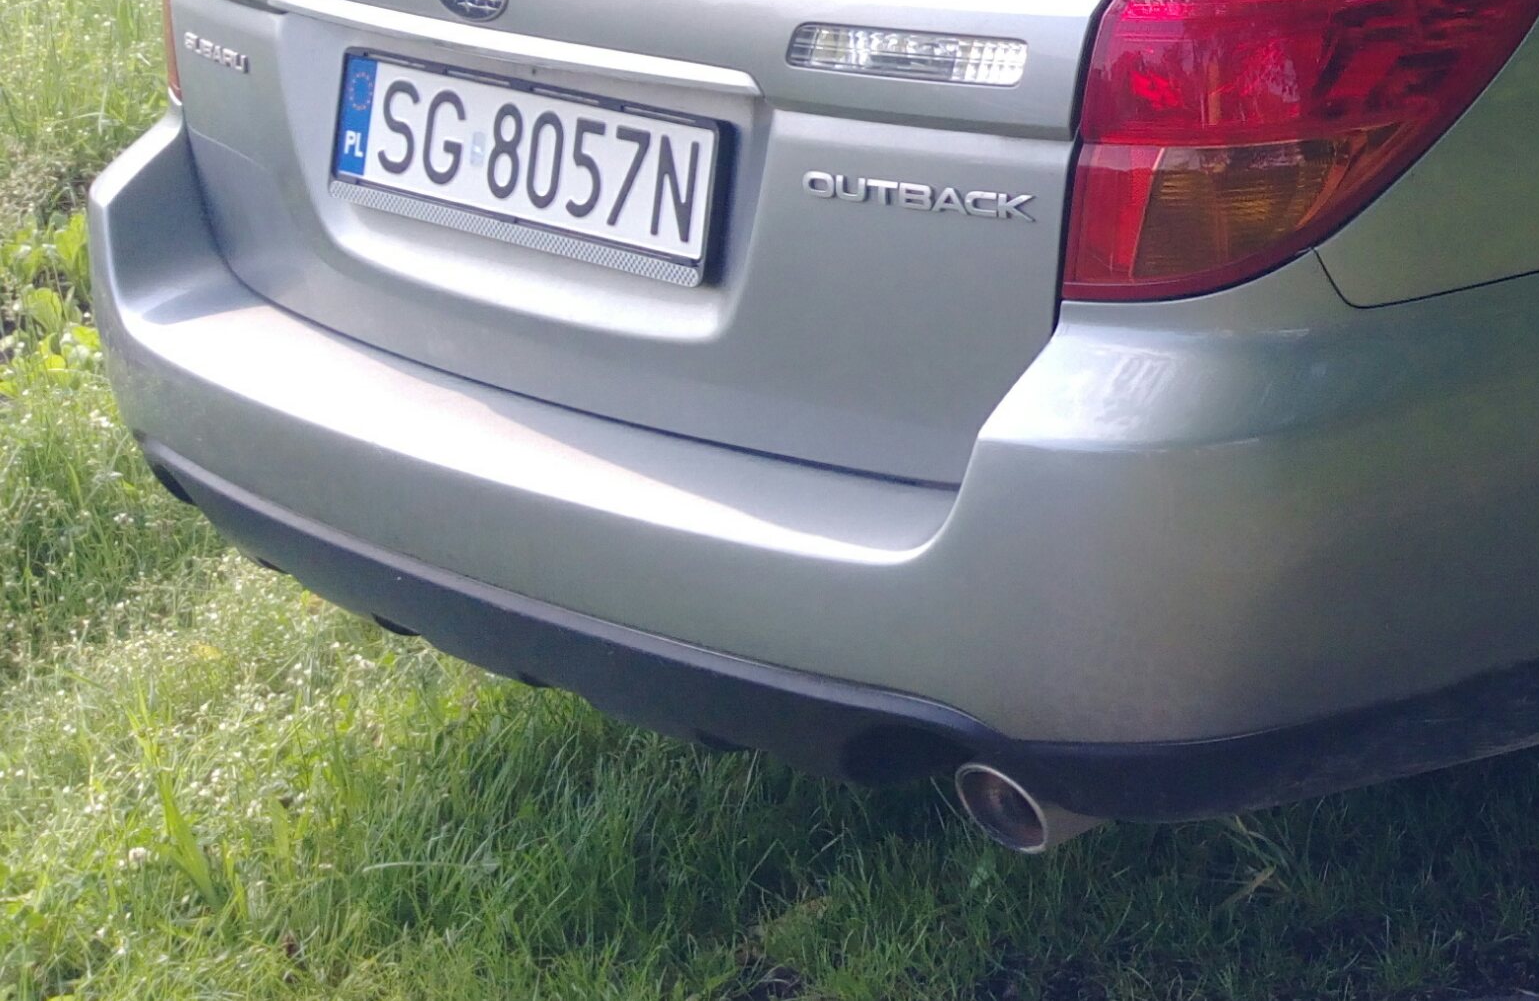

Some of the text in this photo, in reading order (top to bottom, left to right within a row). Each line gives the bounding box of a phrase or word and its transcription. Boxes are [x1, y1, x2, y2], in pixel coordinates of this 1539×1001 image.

[343, 130, 364, 158] PL
[377, 79, 700, 243] SG 8057N
[802, 170, 1037, 223] OUTBACK
